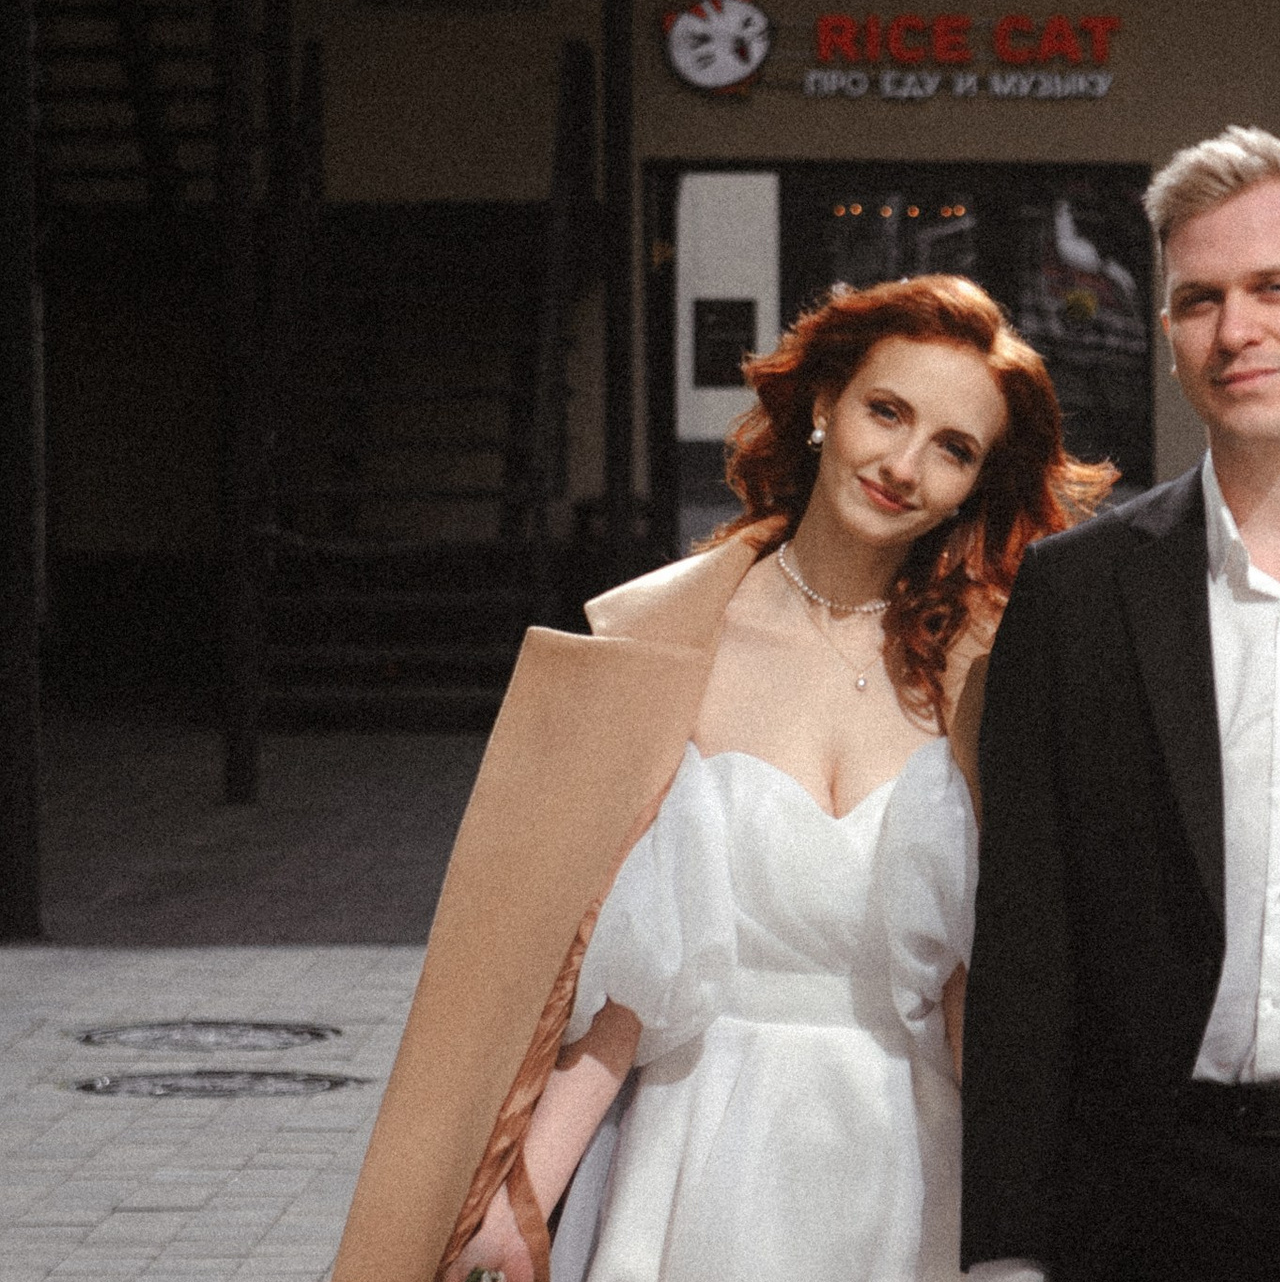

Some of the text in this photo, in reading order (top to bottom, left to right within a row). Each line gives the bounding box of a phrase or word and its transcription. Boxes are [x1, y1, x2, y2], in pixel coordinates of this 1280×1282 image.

[816, 13, 1122, 65] RICE CAT
[803, 69, 1114, 100] ПРО ЕДУ И МУЗЫКУ
